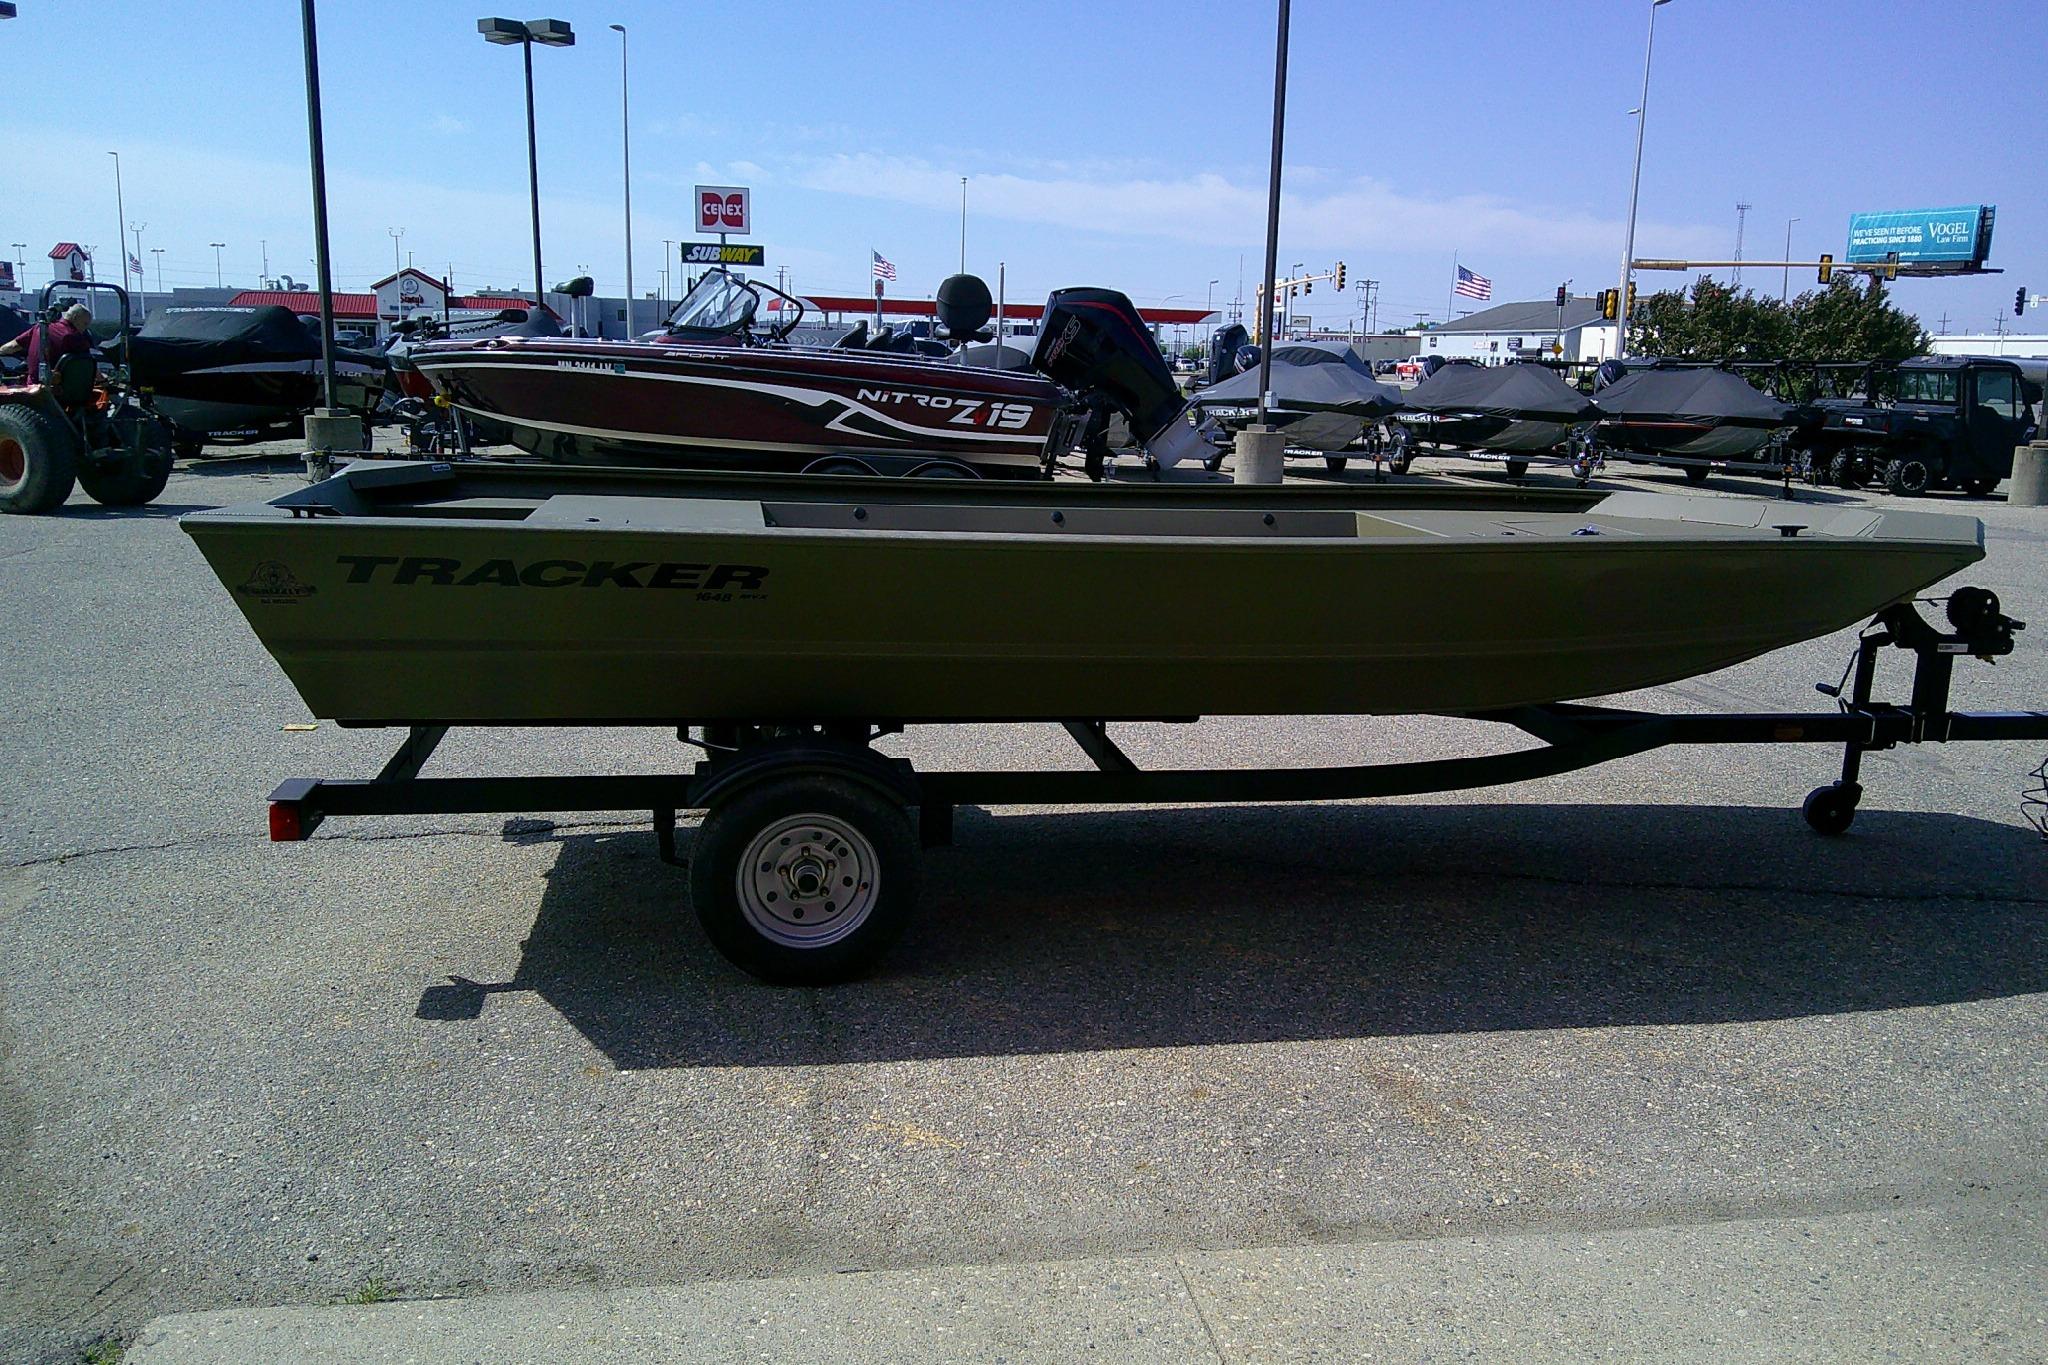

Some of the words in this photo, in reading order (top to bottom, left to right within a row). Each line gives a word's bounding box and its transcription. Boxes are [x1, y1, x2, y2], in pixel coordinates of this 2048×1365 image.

[703, 203, 742, 216] CENEX
[1874, 228, 1888, 236] SEEN
[1929, 222, 1969, 238] VOGEL
[1853, 237, 1888, 245] PRACTICING
[1937, 234, 1951, 243] Law
[1952, 233, 1969, 243] Firm
[686, 246, 759, 263] SUBWAY
[1469, 453, 1511, 461] TRACKER
[336, 555, 770, 590] TRACKER
